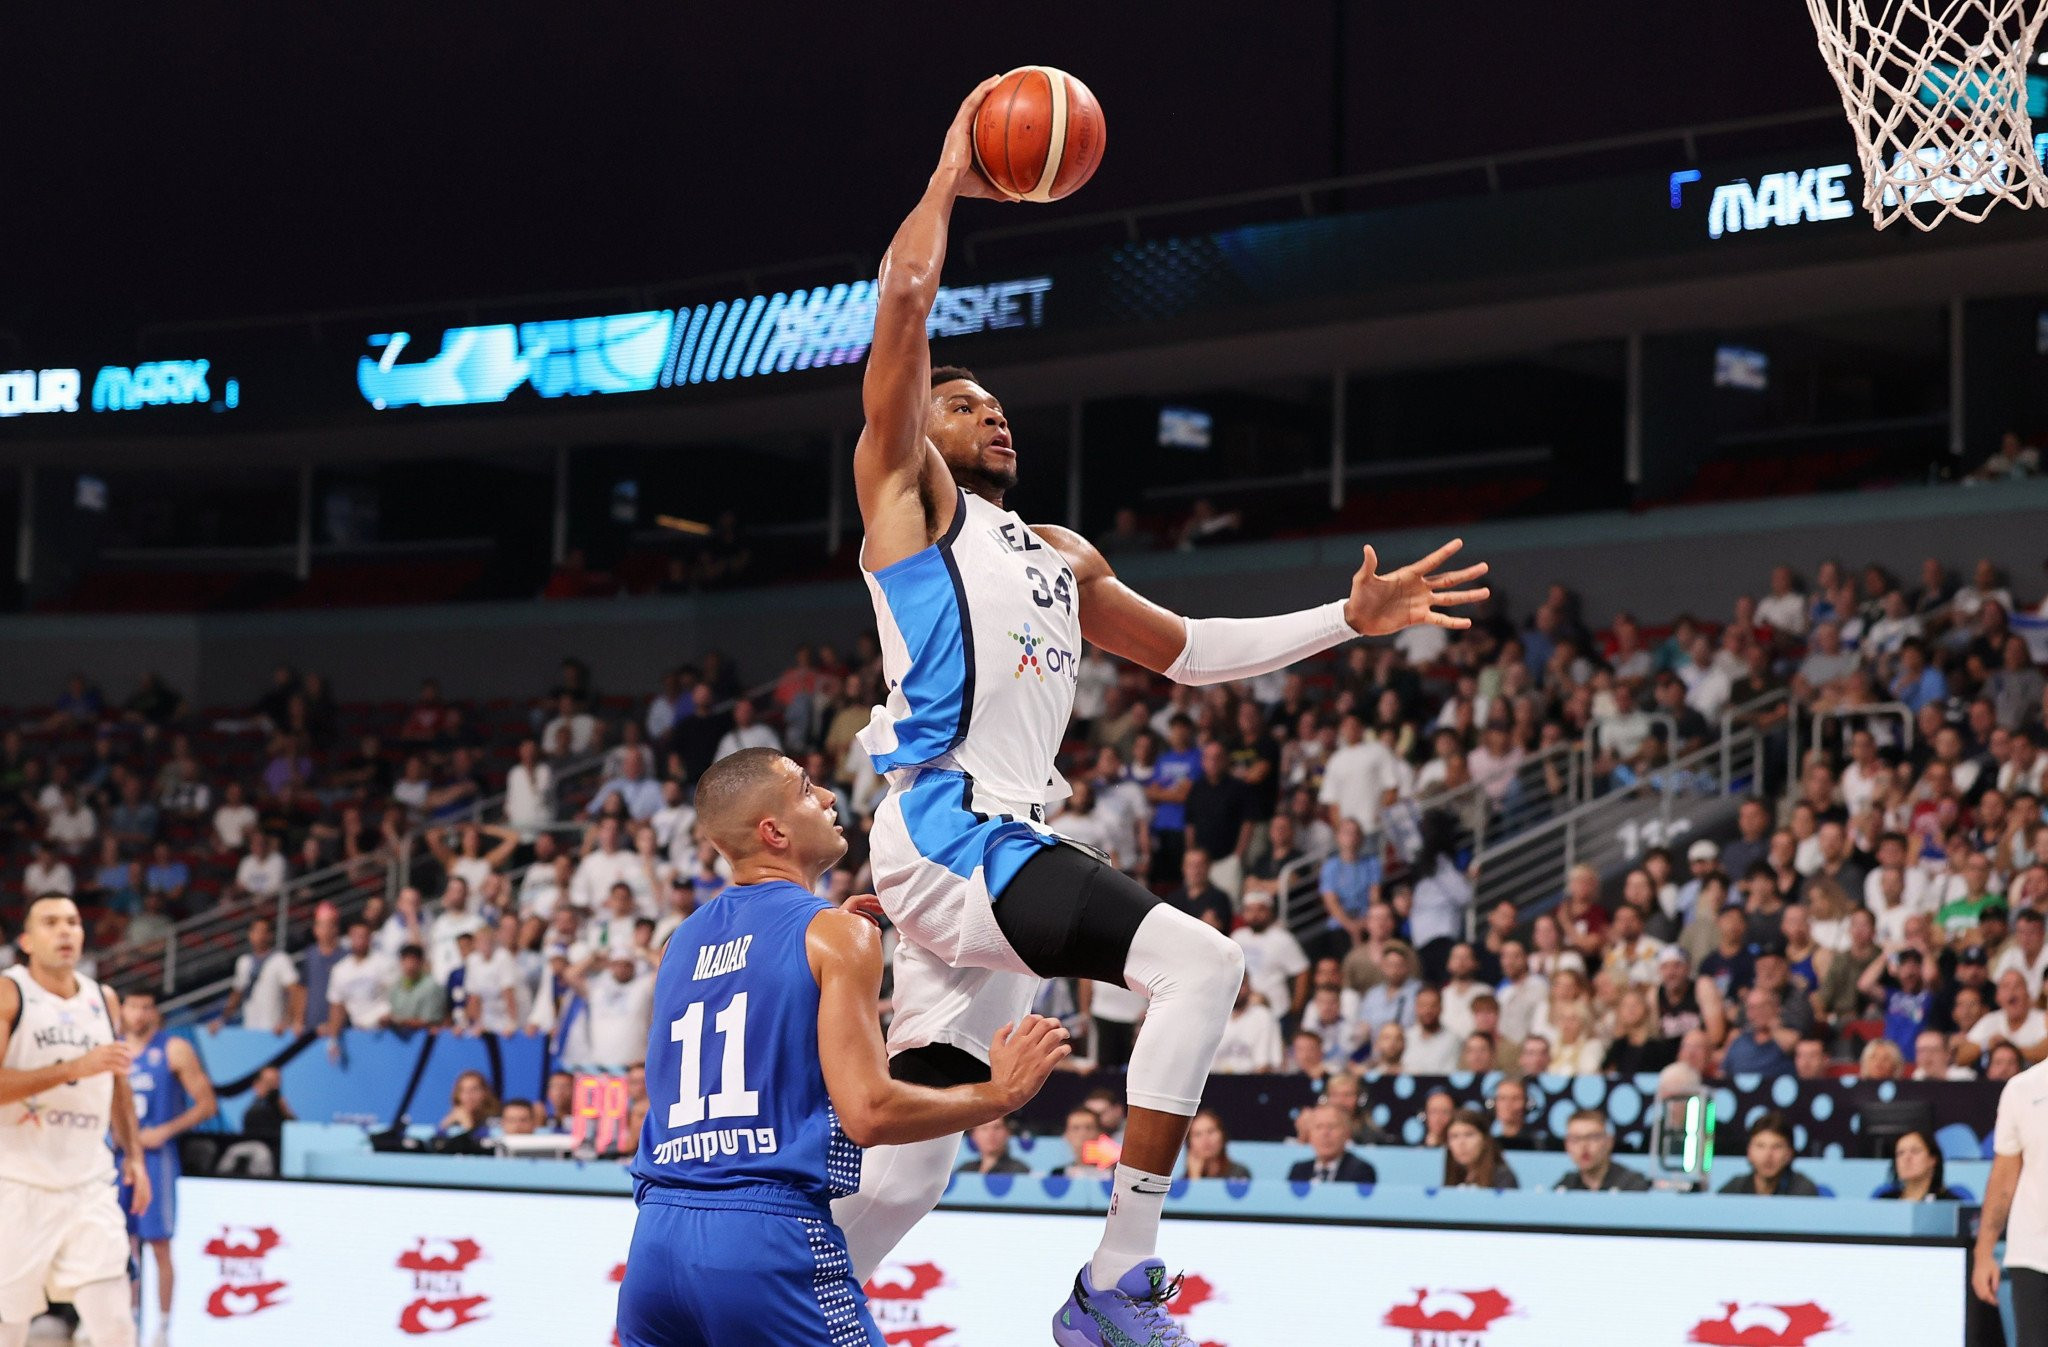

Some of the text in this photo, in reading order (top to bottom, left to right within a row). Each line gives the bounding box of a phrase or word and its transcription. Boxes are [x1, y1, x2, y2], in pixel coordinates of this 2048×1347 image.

[1709, 164, 1853, 239] MAKE
[92, 359, 210, 413] MARK
[1025, 566, 1073, 617] 34
[692, 935, 753, 981] MADAR
[34, 1026, 99, 1049] HELLA
[667, 991, 759, 1129] 11
